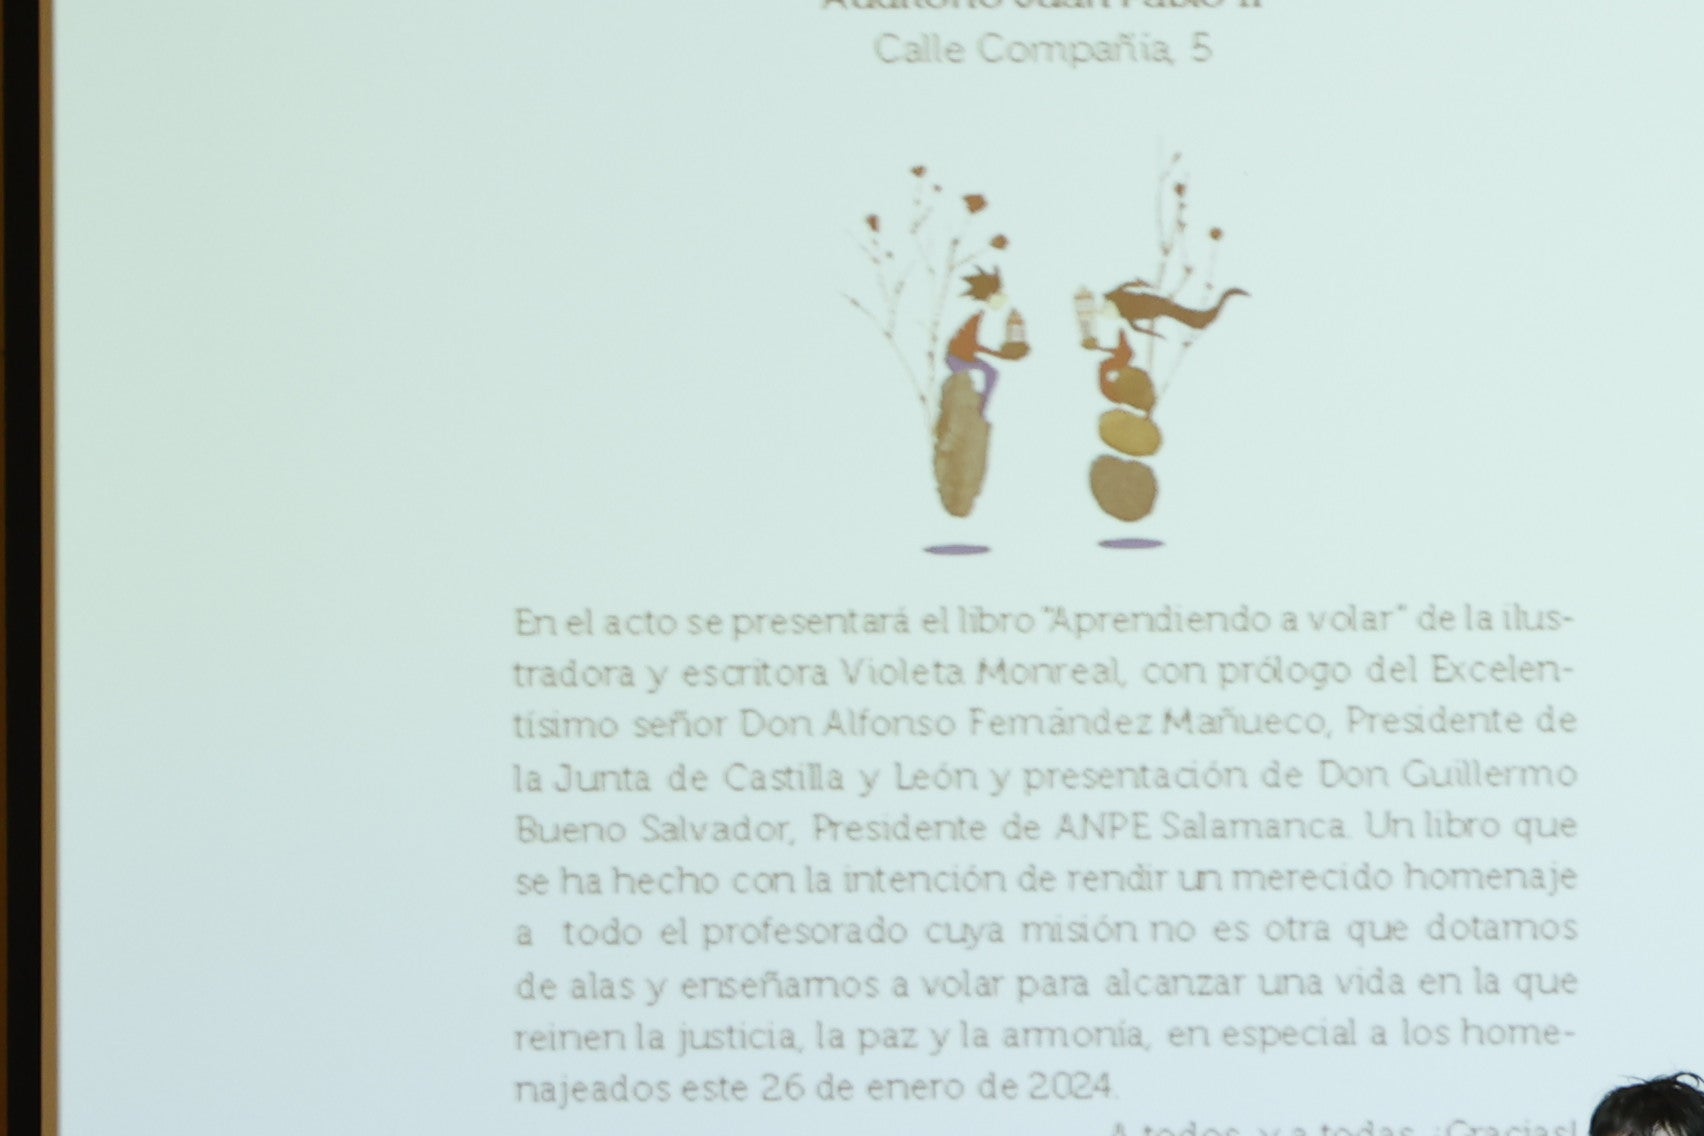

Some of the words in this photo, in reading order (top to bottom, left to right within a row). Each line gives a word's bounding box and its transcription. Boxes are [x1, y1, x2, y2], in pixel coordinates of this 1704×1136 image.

[874, 32, 964, 64] Calle
[1192, 31, 1213, 62] 5
[512, 659, 635, 687] tradora
[647, 666, 668, 694] y
[681, 659, 828, 687] escritora
[840, 658, 964, 687] Violeta
[1143, 662, 1206, 685] con
[1218, 655, 1351, 691] prólogo
[1366, 654, 1417, 683] del
[1431, 652, 1573, 683] Excelen-
[633, 710, 727, 739] señor
[739, 708, 813, 738] Don
[822, 708, 956, 737] Alfonso
[1346, 704, 1523, 734] Presidente
[1536, 704, 1577, 733] de
[513, 764, 542, 793] la
[554, 762, 651, 792] Junta
[667, 761, 708, 792] de
[723, 762, 844, 792] Castilla
[859, 770, 879, 798] y
[894, 761, 979, 791] León
[990, 769, 1010, 797] y
[1023, 761, 1248, 795] presentación
[1261, 760, 1303, 788] de
[1318, 758, 1389, 788] Don
[1402, 758, 1577, 788] Guillermo
[515, 814, 626, 844] Bueno
[812, 813, 987, 842] Presidente
[1001, 812, 1040, 840] de
[1055, 811, 1151, 840] ANPE
[1365, 810, 1414, 839] Un
[1424, 810, 1500, 838] libro
[1513, 817, 1577, 844] que
[516, 924, 533, 946] a
[563, 917, 642, 946] todo
[659, 916, 688, 946] el
[702, 915, 908, 951] profesorado
[925, 921, 1004, 950] cuya
[1021, 915, 1138, 943] misión
[1150, 920, 1196, 943] no
[1212, 920, 1249, 942] es
[1265, 916, 1331, 942] otra
[1346, 920, 1408, 948] que
